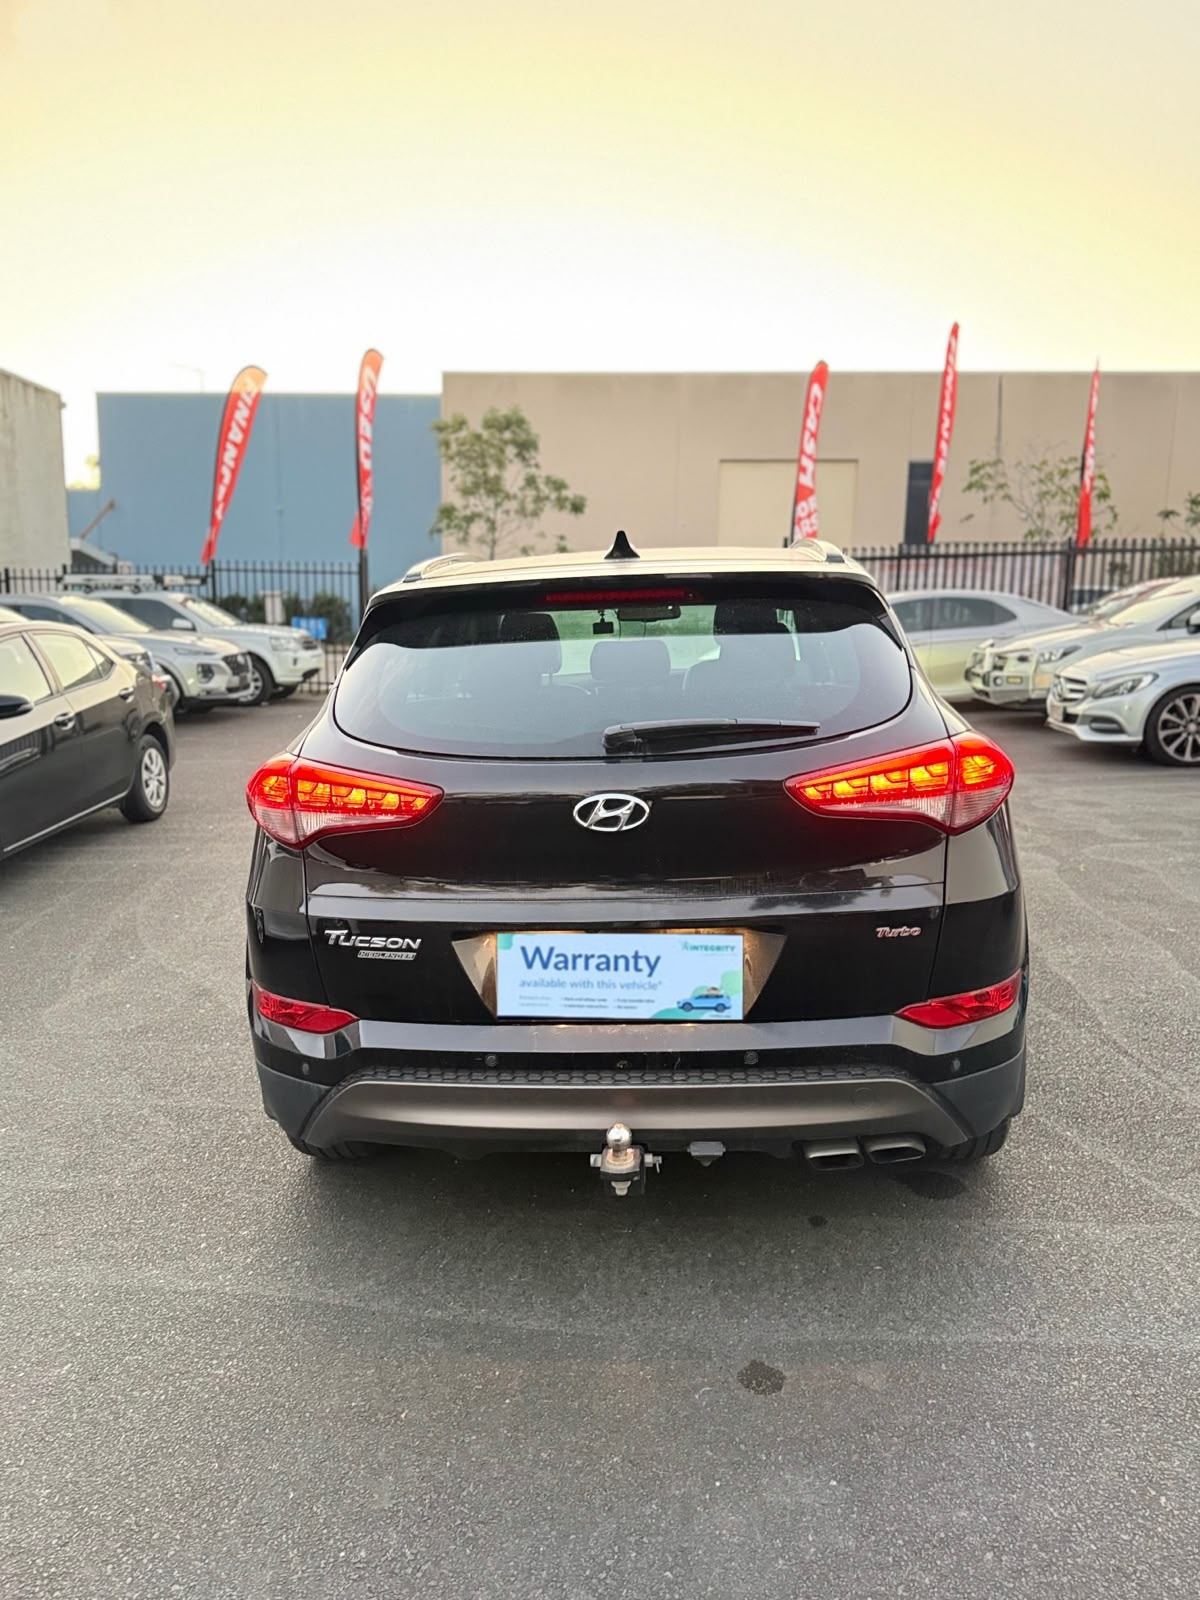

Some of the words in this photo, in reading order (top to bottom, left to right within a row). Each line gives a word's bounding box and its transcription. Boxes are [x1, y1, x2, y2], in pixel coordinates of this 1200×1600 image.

[799, 382, 823, 488] CASH
[324, 929, 422, 950] TUCSON
[876, 926, 921, 938] Turbo
[520, 946, 661, 978] Warranty
[519, 978, 566, 989] available
[570, 979, 594, 989] with
[597, 979, 617, 990] this
